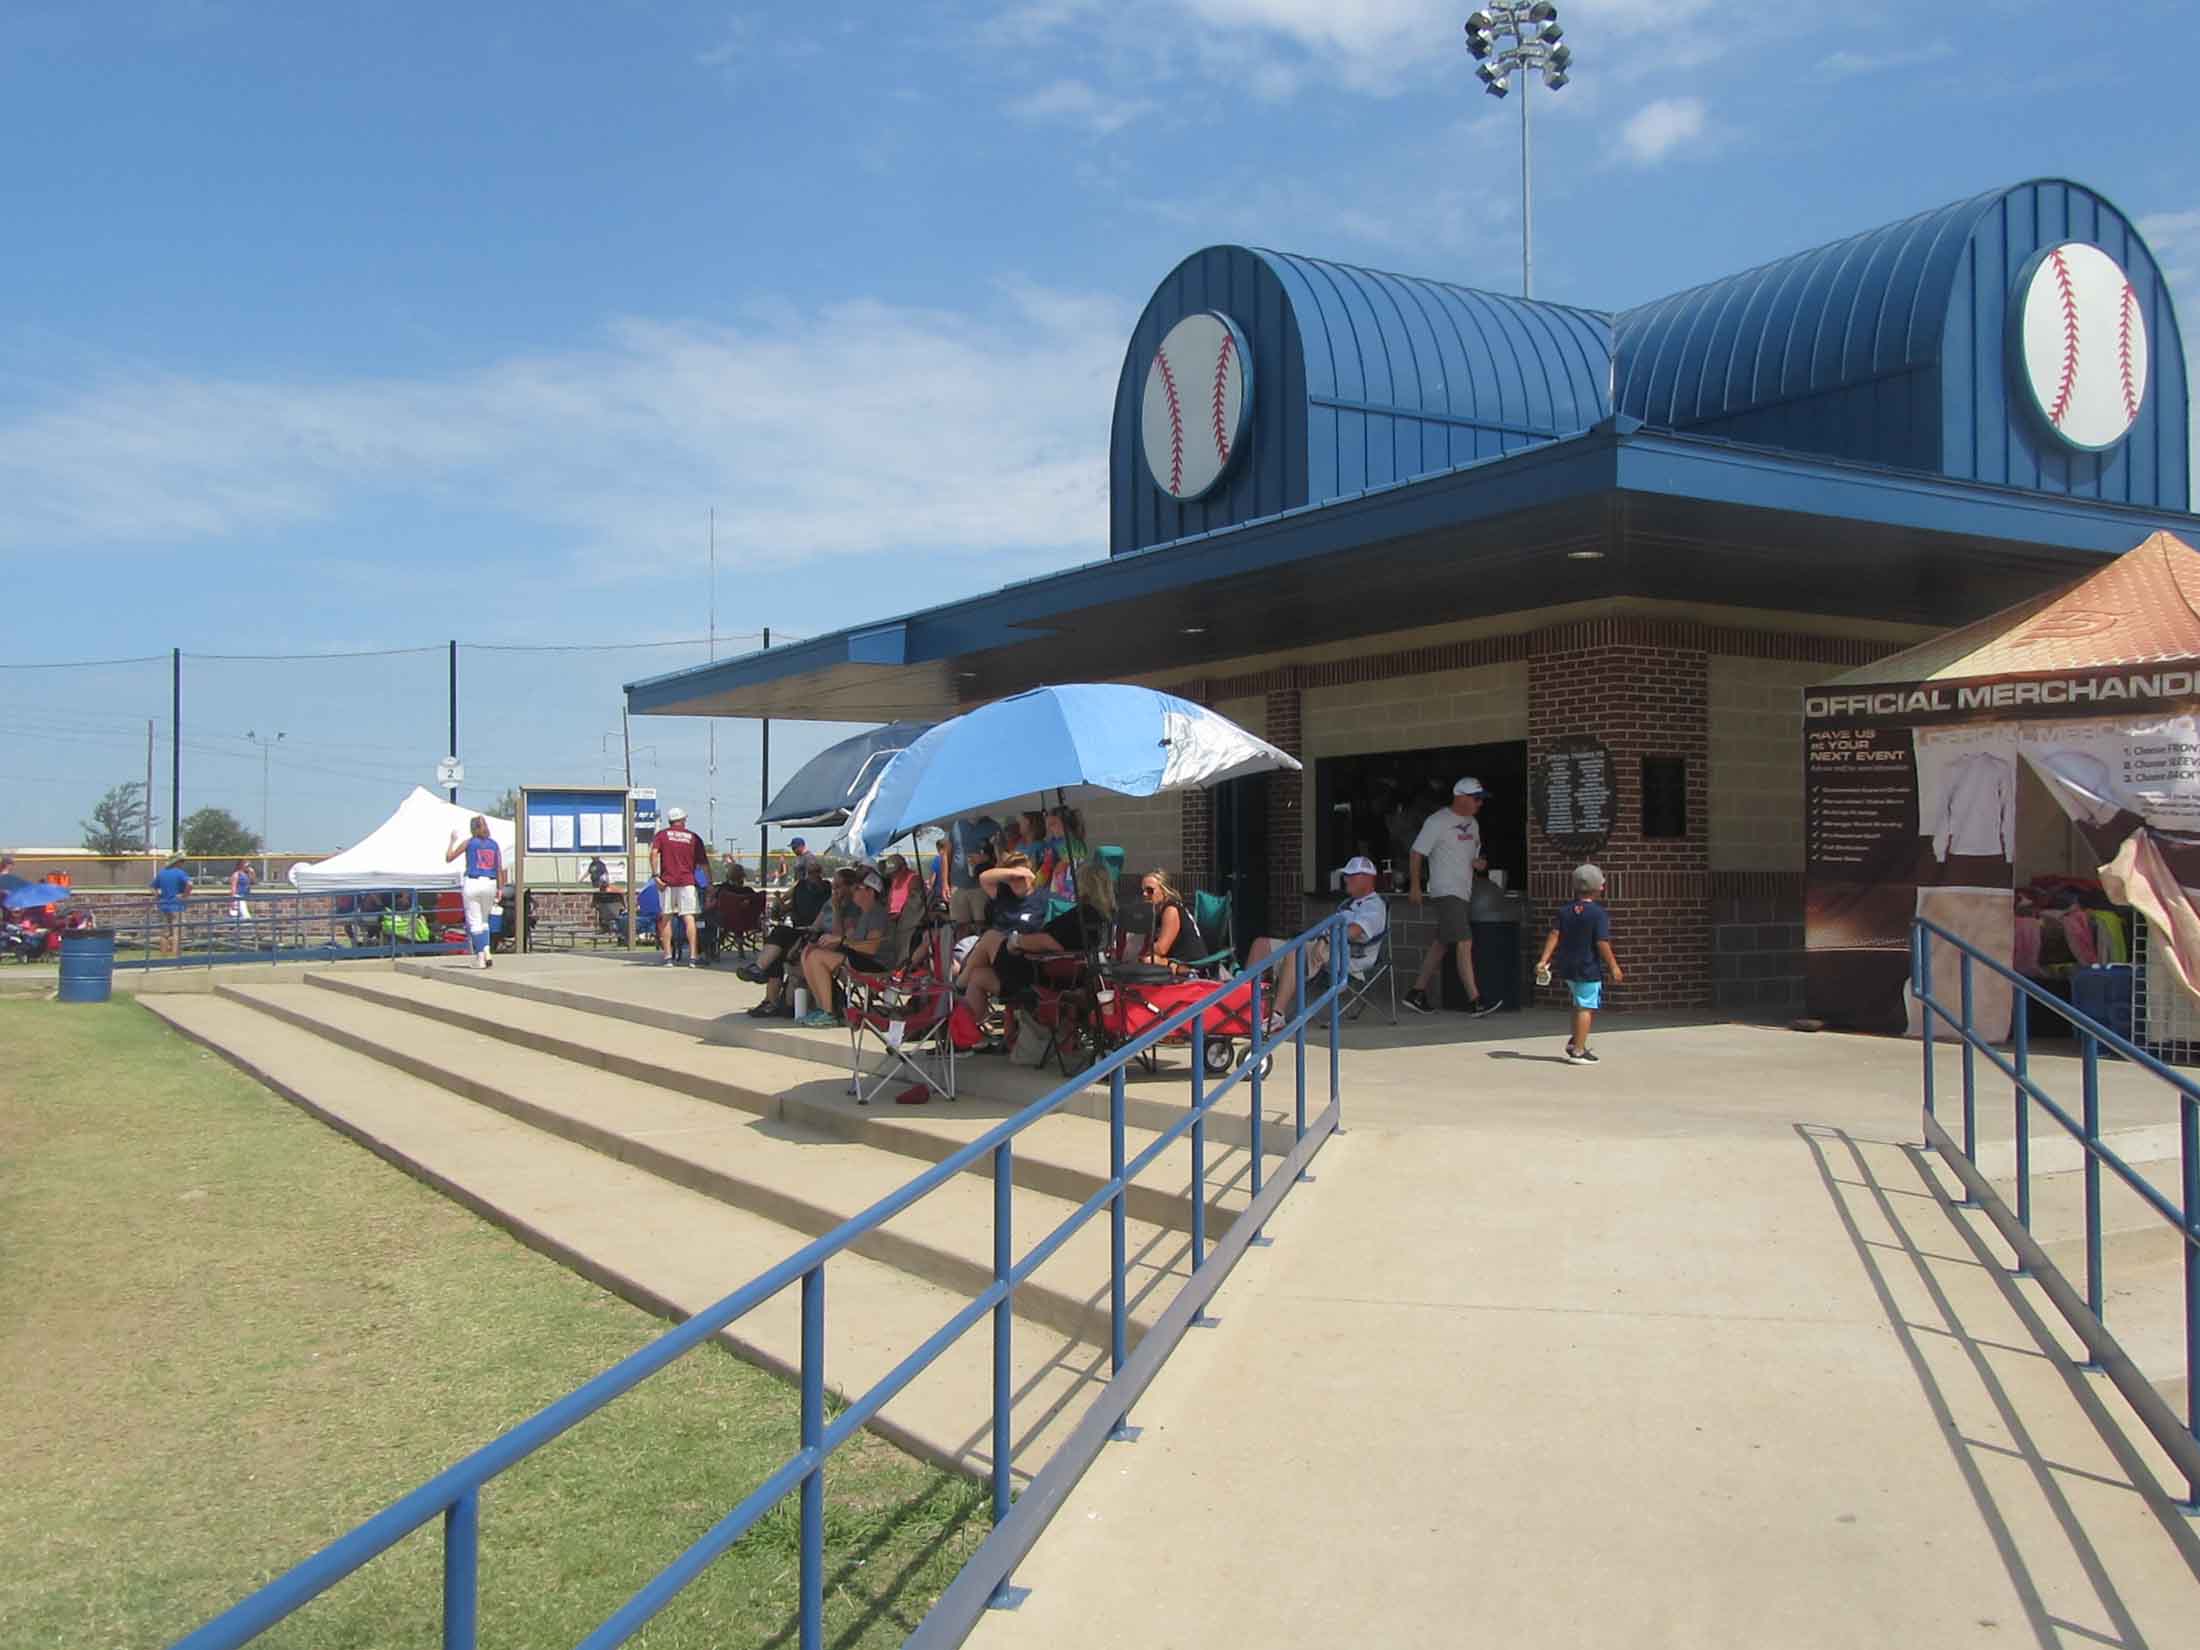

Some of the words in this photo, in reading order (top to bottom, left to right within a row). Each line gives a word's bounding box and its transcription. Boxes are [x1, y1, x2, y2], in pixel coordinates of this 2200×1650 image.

[1806, 687, 1952, 718] OFFICIAL
[1809, 729, 1851, 740] HAVE
[1855, 728, 1876, 739] US
[1828, 740, 1869, 750] YOUR
[1809, 751, 1852, 761] NEXT
[1856, 750, 1905, 761] EVENT
[447, 768, 455, 779] 2
